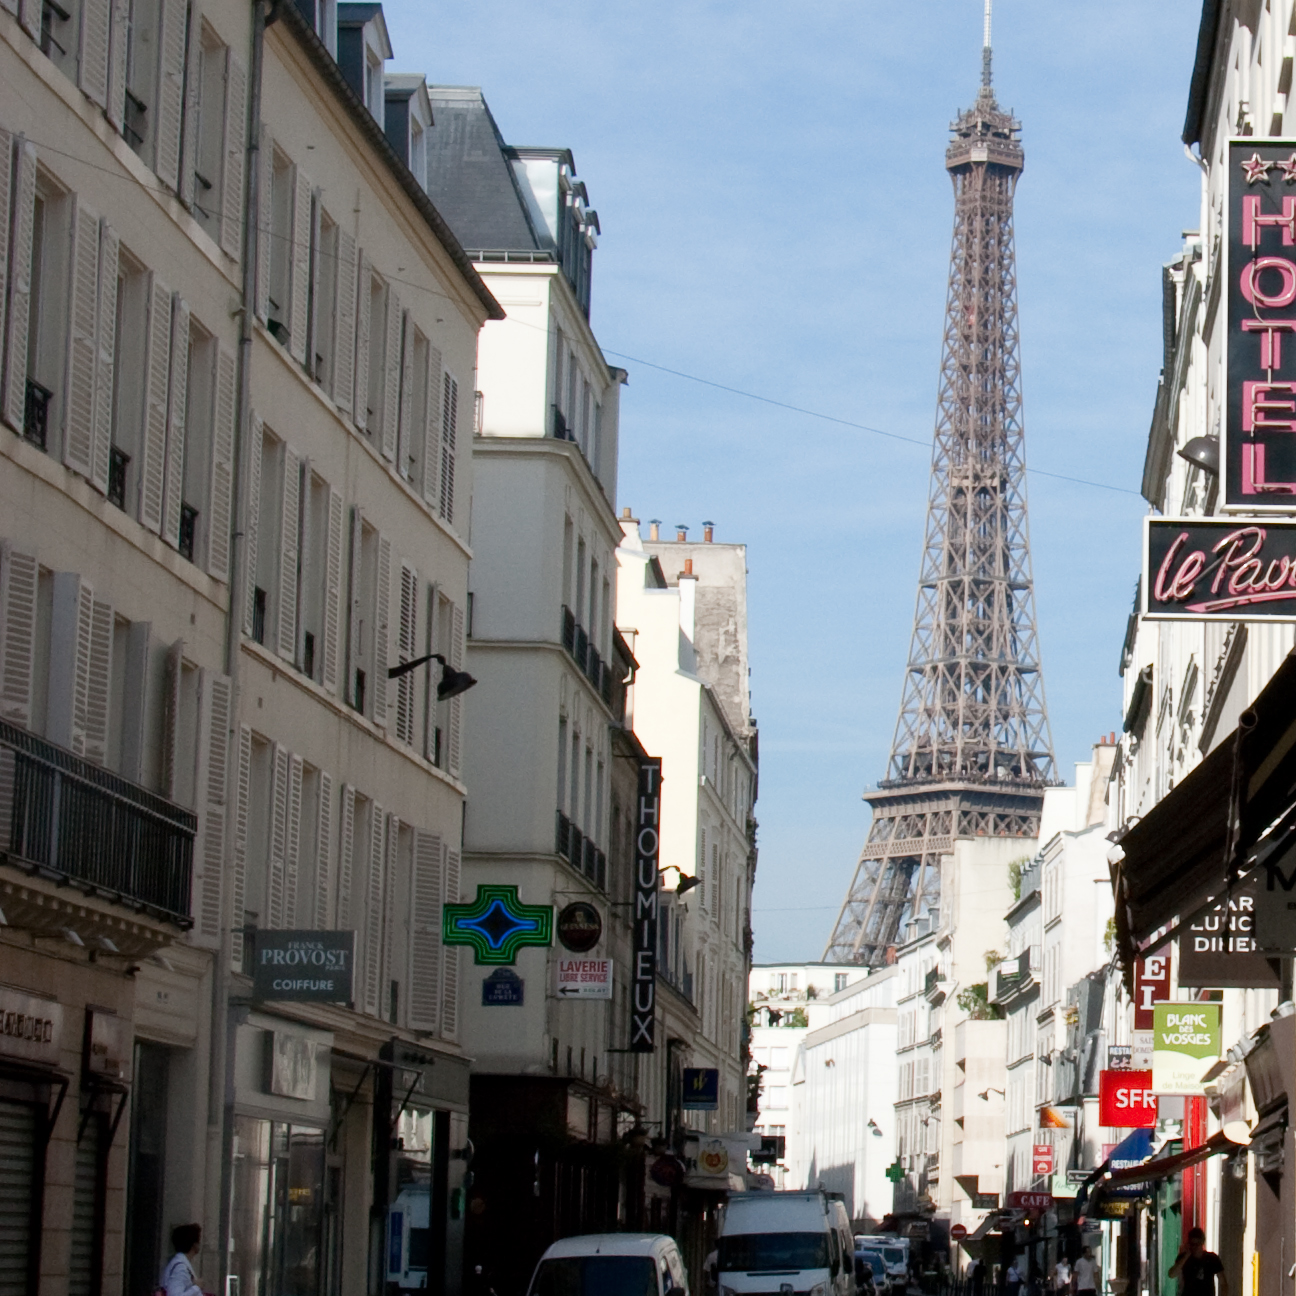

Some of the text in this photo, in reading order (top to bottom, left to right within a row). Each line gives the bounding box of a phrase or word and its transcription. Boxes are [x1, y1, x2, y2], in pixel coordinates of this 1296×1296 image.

[633, 765, 659, 1044] THOUMIEUX
[261, 949, 348, 966] PROVOST
[560, 961, 607, 973] LAVERIE
[560, 973, 607, 983] LIBRE SERVICE
[273, 979, 334, 991] COIFFURE
[1167, 1014, 1207, 1027] BLANC
[1179, 1025, 1194, 1033] DES
[1162, 1033, 1211, 1045] VOSGES
[1172, 1072, 1196, 1081] Linge
[1115, 1089, 1156, 1109] SFR
